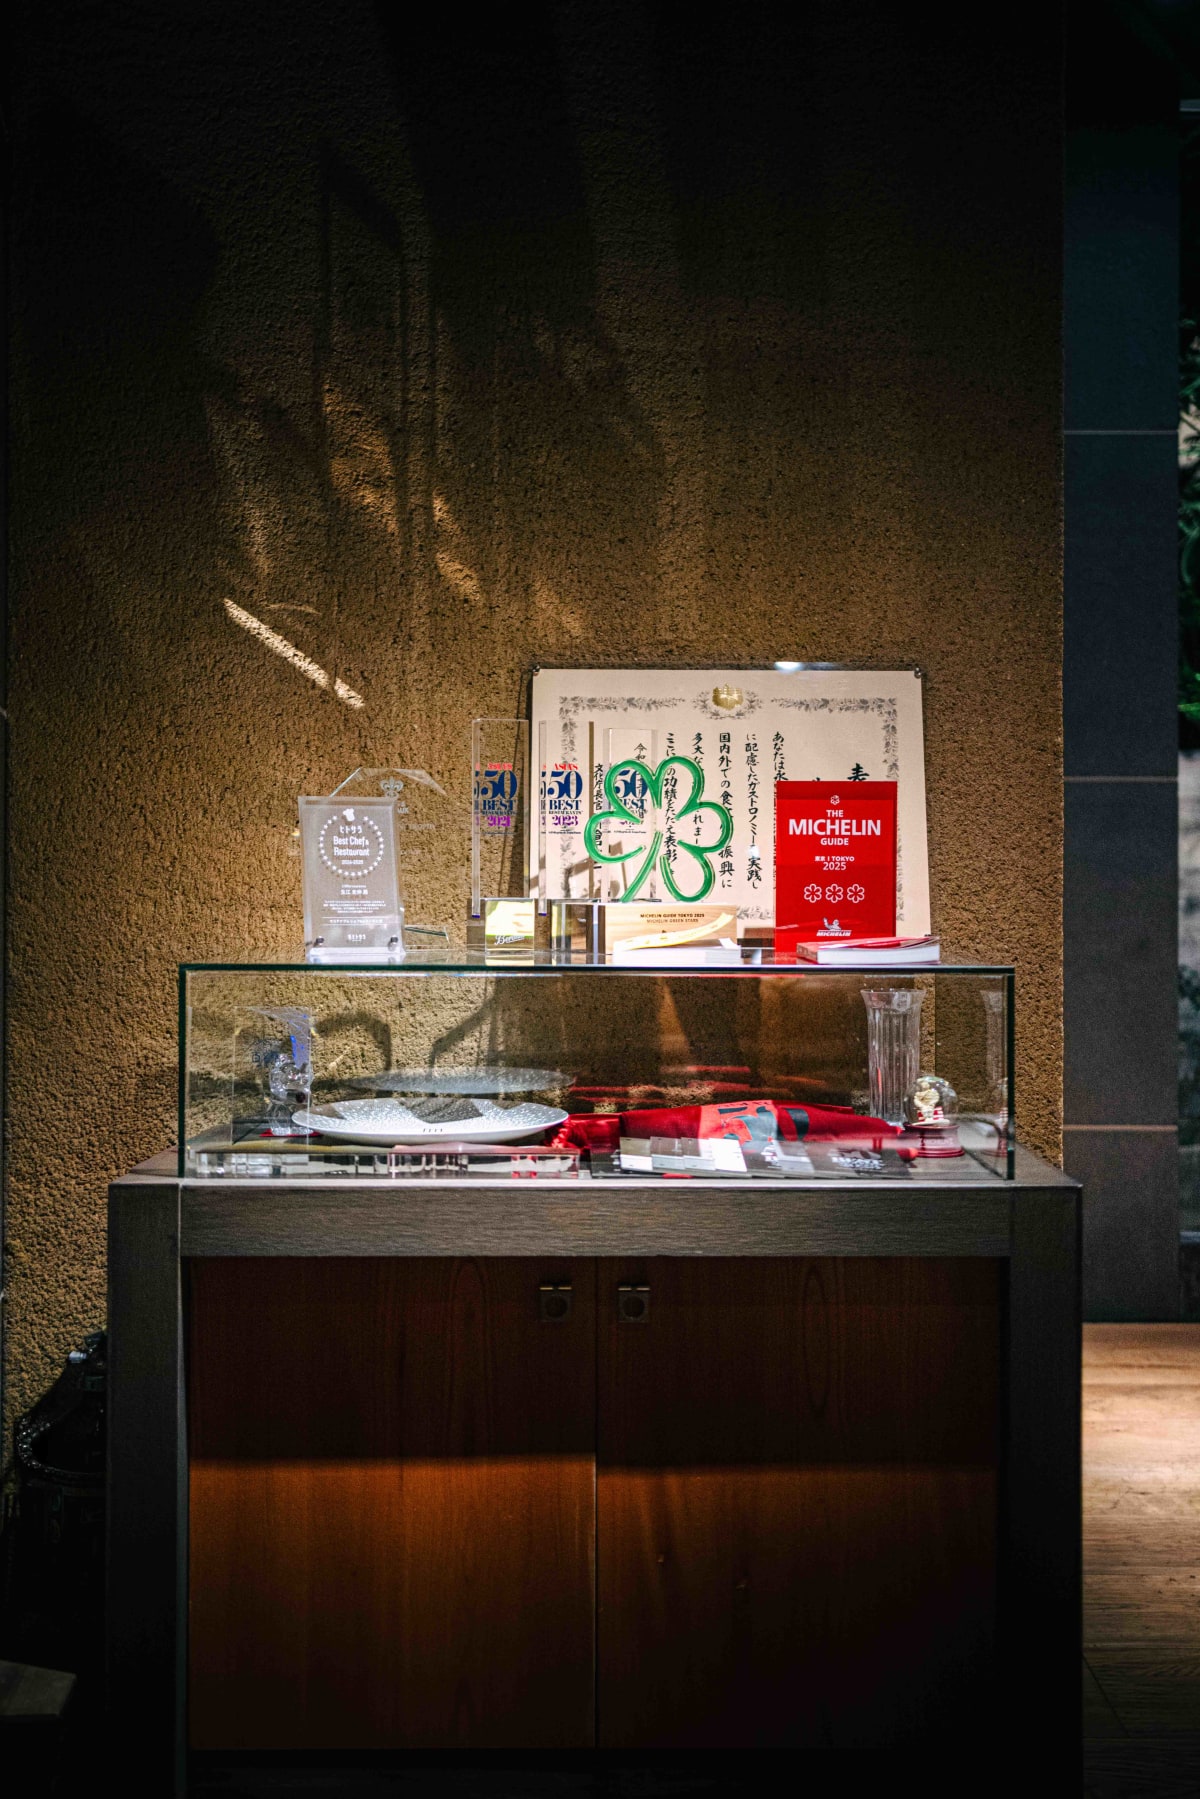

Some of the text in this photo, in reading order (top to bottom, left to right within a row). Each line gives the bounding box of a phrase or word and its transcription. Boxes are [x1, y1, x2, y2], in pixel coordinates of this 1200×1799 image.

[481, 770, 518, 800] 50
[547, 770, 583, 800] 50
[615, 769, 649, 799] 50
[482, 799, 517, 811] BEST
[549, 799, 582, 811] BEST
[718, 732, 735, 888] 国内外での食振興に
[744, 733, 763, 889] に配慮したガストロノミー実践し
[826, 809, 844, 818] THE
[552, 814, 579, 827] 2023
[788, 818, 882, 836] MICHELIN
[333, 835, 348, 845] Best
[820, 837, 850, 846] GUIDE
[333, 847, 370, 856] Restaurant
[823, 861, 847, 871] 2025
